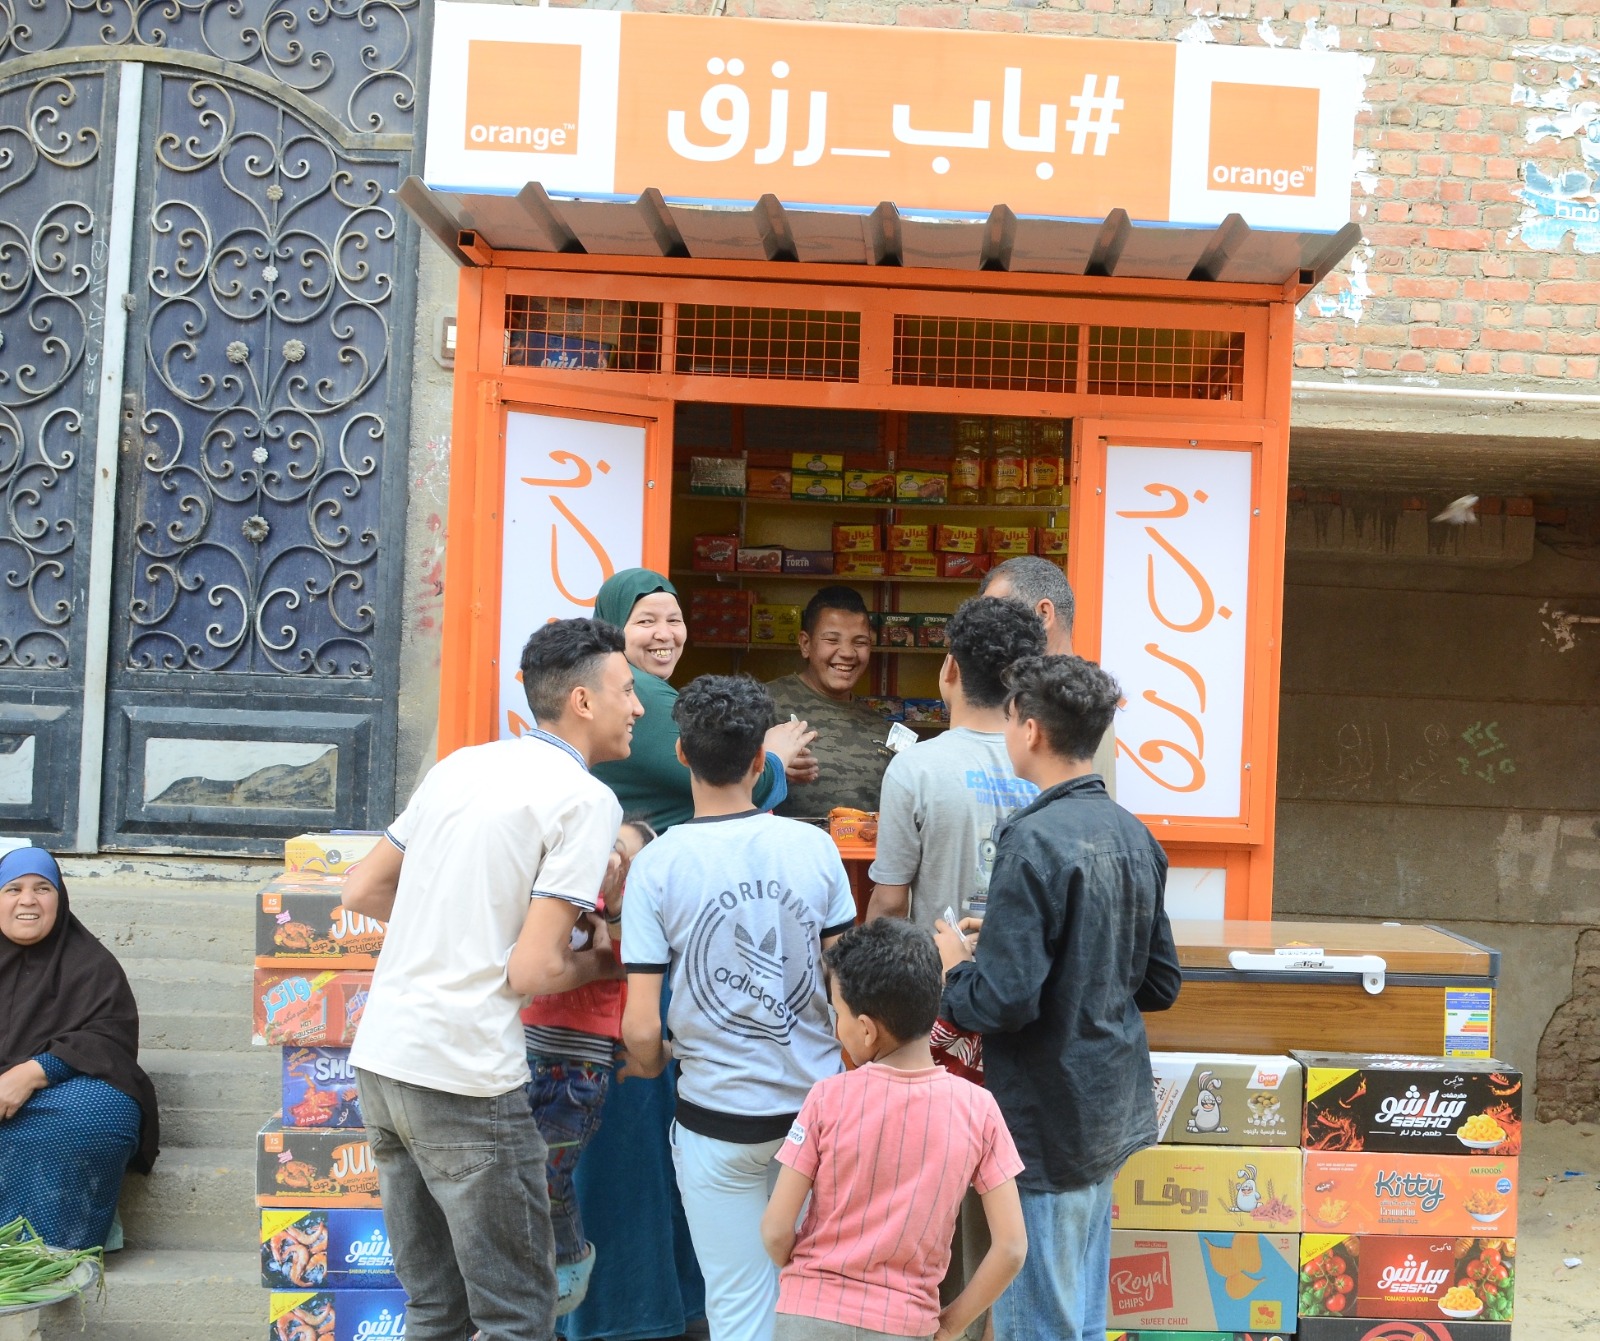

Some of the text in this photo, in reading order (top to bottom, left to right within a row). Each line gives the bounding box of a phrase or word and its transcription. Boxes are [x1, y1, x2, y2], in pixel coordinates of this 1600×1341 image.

[786, 559, 810, 567] TORTA
[349, 942, 383, 953] CHICKE
[714, 967, 787, 1019] adidas
[1375, 1084, 1467, 1123] ساشو
[349, 1181, 378, 1193] CHICK
[1374, 1170, 1445, 1213] Kitty
[357, 1257, 395, 1266] SASH
[1111, 1256, 1169, 1301] Royal
[1377, 1254, 1450, 1289] ساشو
[1118, 1296, 1144, 1310] CHIPS
[1140, 1317, 1165, 1326] SWEET
